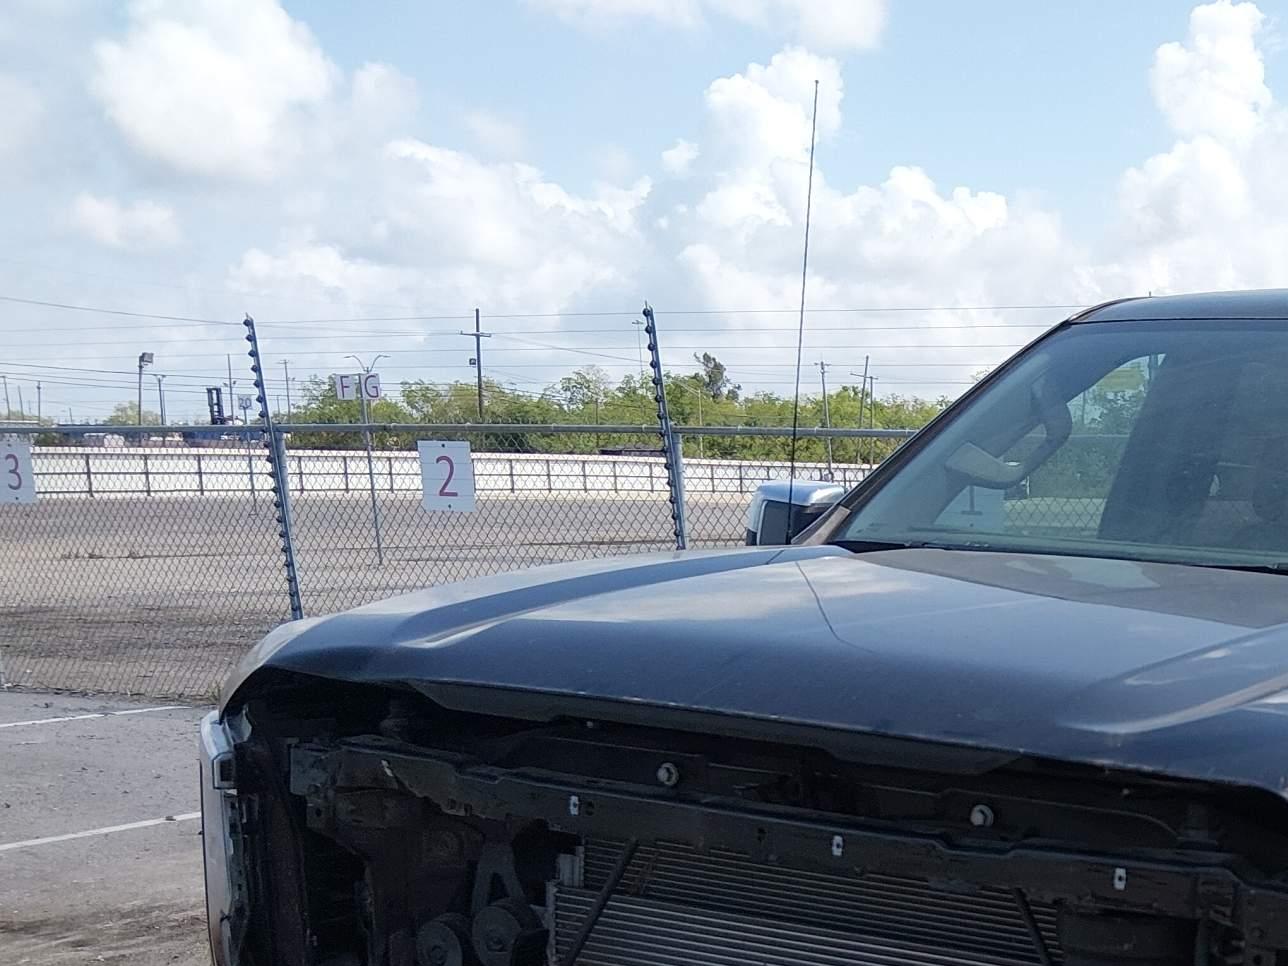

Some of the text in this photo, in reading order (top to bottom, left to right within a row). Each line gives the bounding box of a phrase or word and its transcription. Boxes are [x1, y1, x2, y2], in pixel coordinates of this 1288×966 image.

[340, 375, 350, 398] F
[364, 374, 379, 398] G
[239, 397, 252, 409] 20
[5, 453, 22, 490] 3
[436, 455, 458, 497] 2
